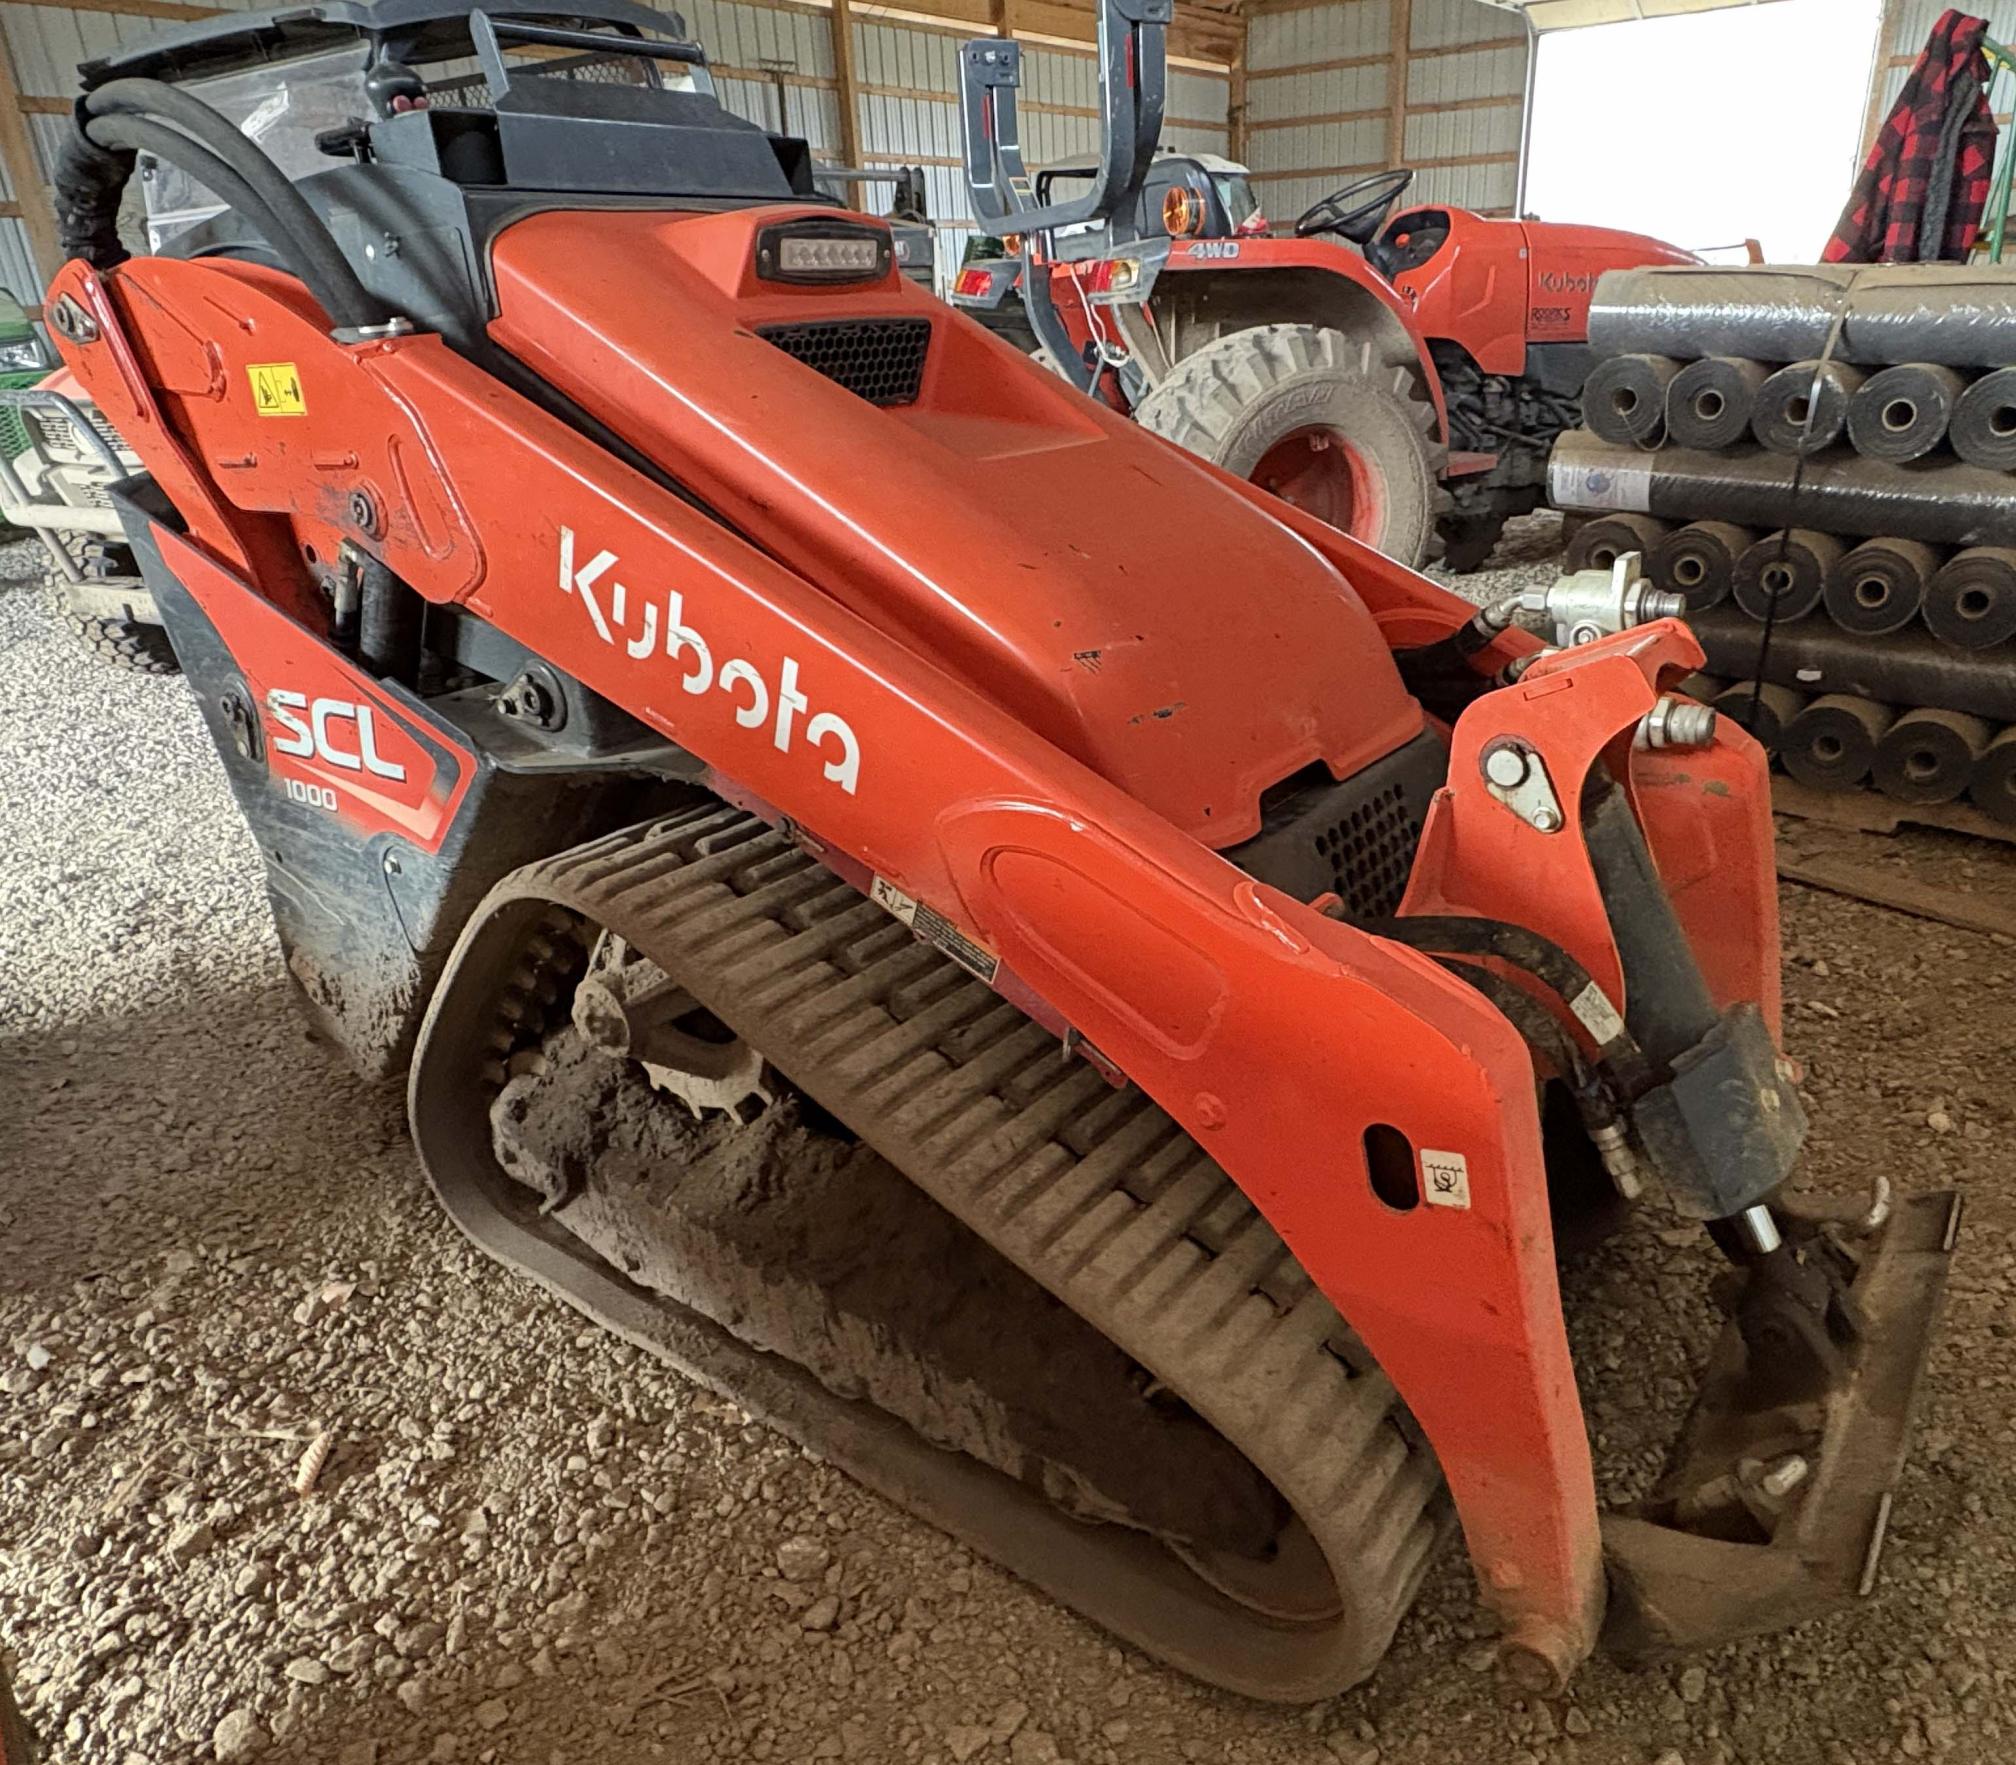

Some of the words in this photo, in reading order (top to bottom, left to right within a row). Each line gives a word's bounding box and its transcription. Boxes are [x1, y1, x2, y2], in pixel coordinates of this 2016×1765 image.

[1187, 241, 1240, 259] 4WD
[1538, 272, 1599, 294] Kubot
[558, 525, 860, 796] Kubota
[267, 688, 407, 783] SCL
[284, 778, 338, 812] 1000
